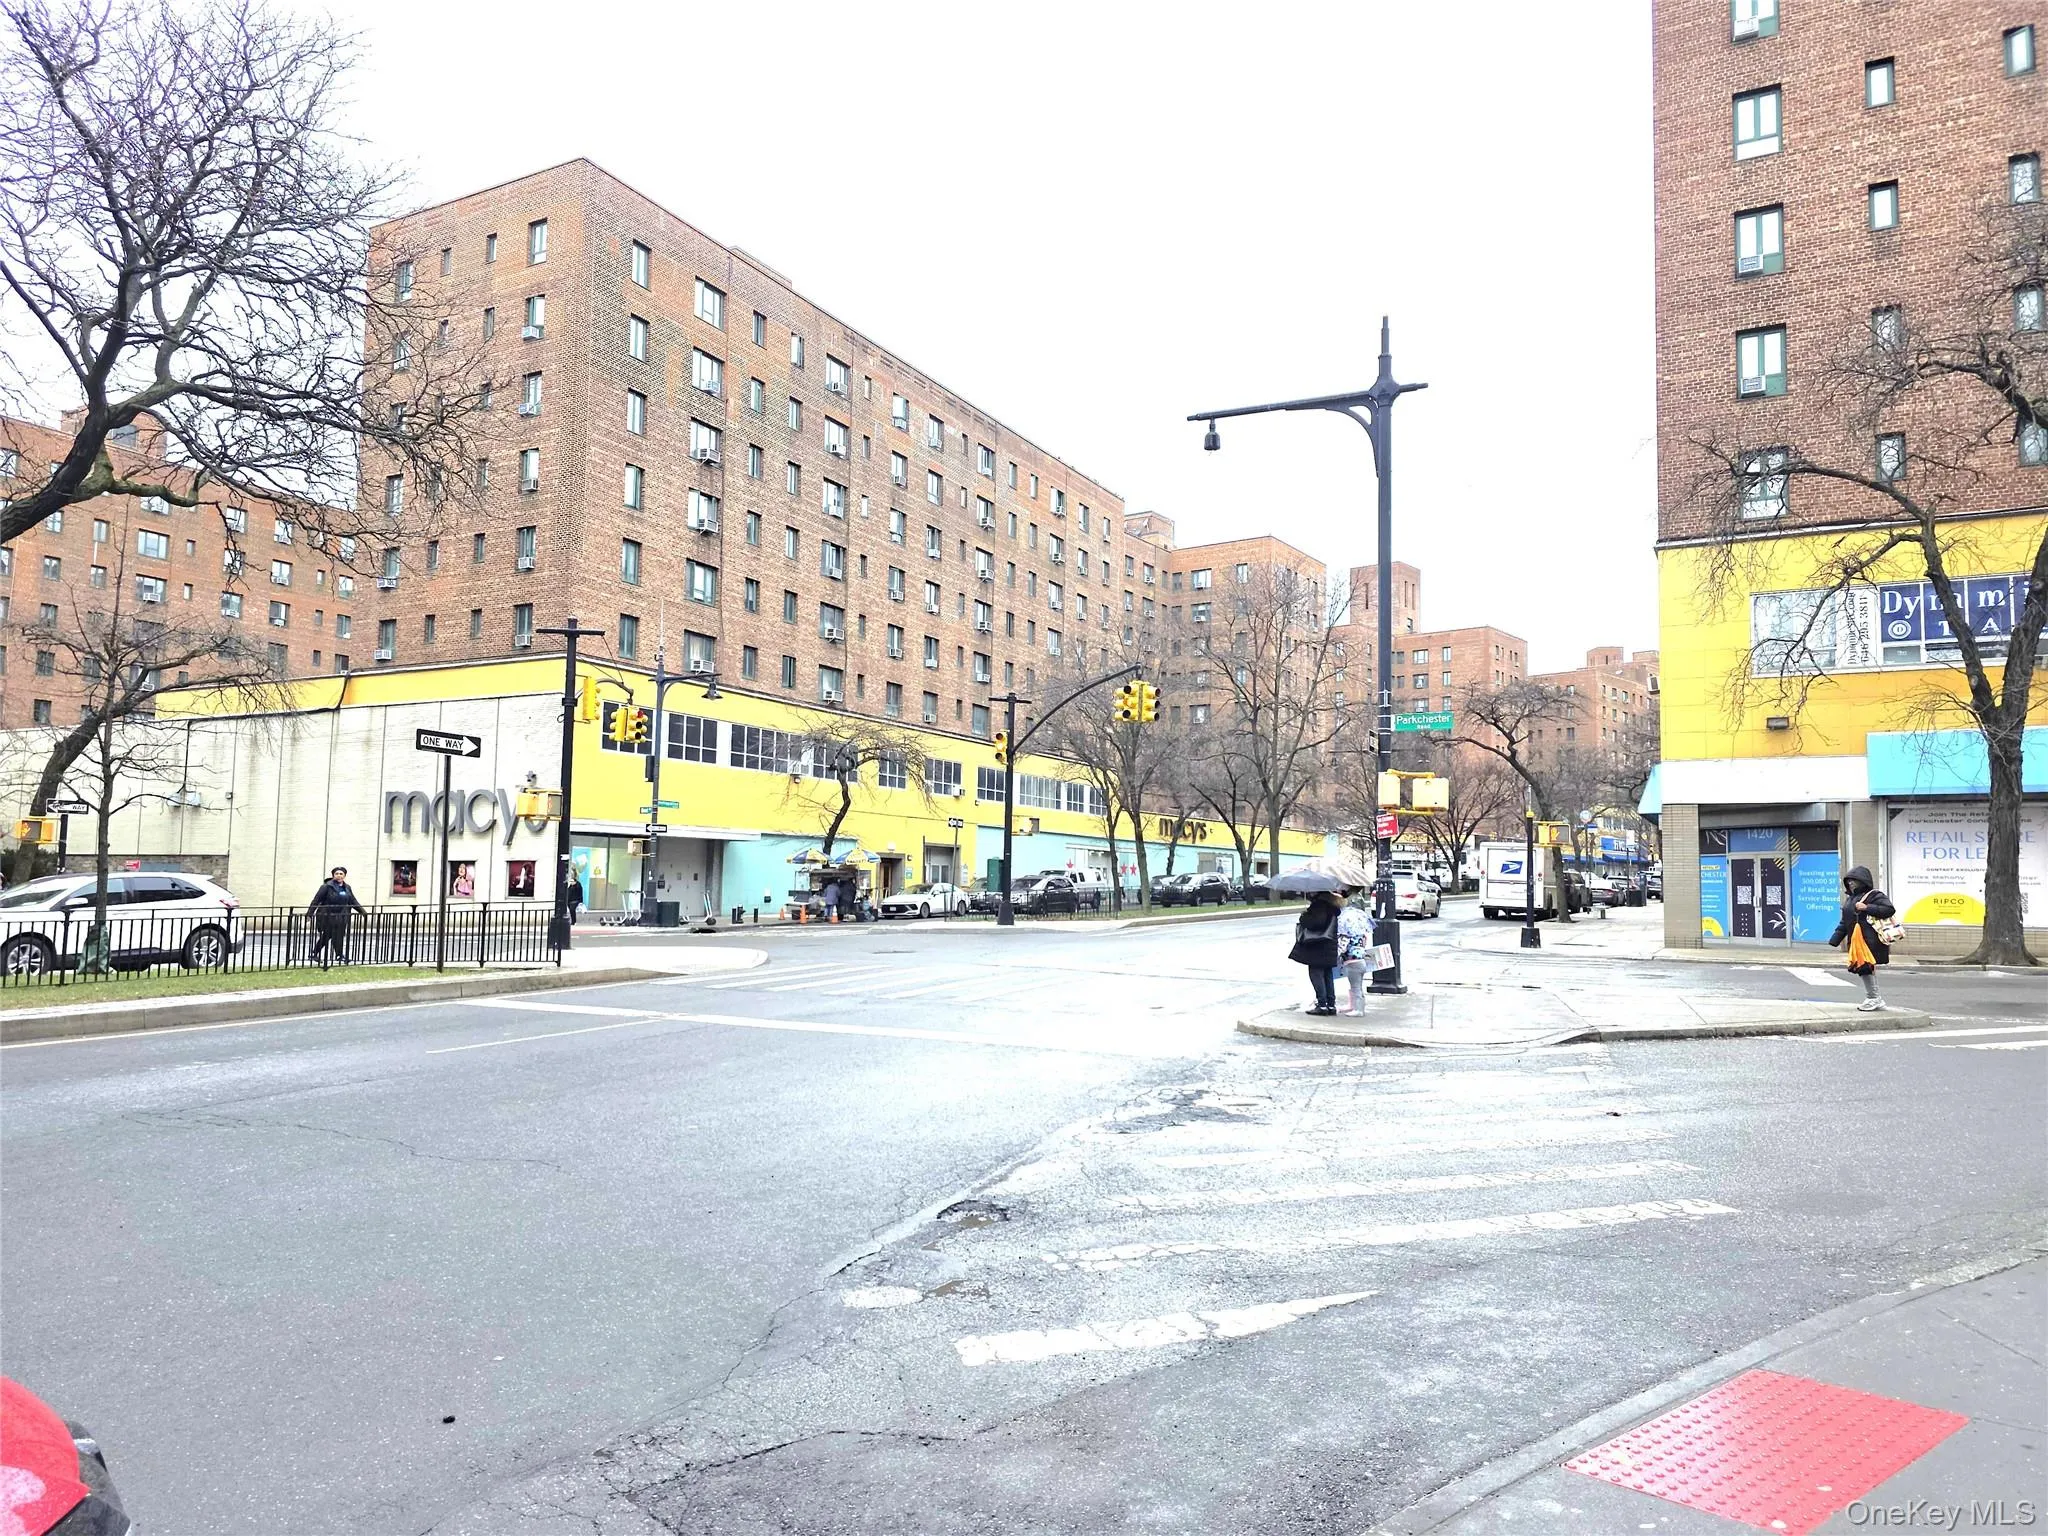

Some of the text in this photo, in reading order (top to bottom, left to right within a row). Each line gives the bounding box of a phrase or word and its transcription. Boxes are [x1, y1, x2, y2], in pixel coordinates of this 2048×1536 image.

[1396, 714, 1451, 724] Parkchester
[423, 736, 464, 749] ONE WAY
[1746, 828, 1773, 840] 1420
[1906, 831, 1968, 843] RETAIL
[1923, 848, 1959, 860] FOR
